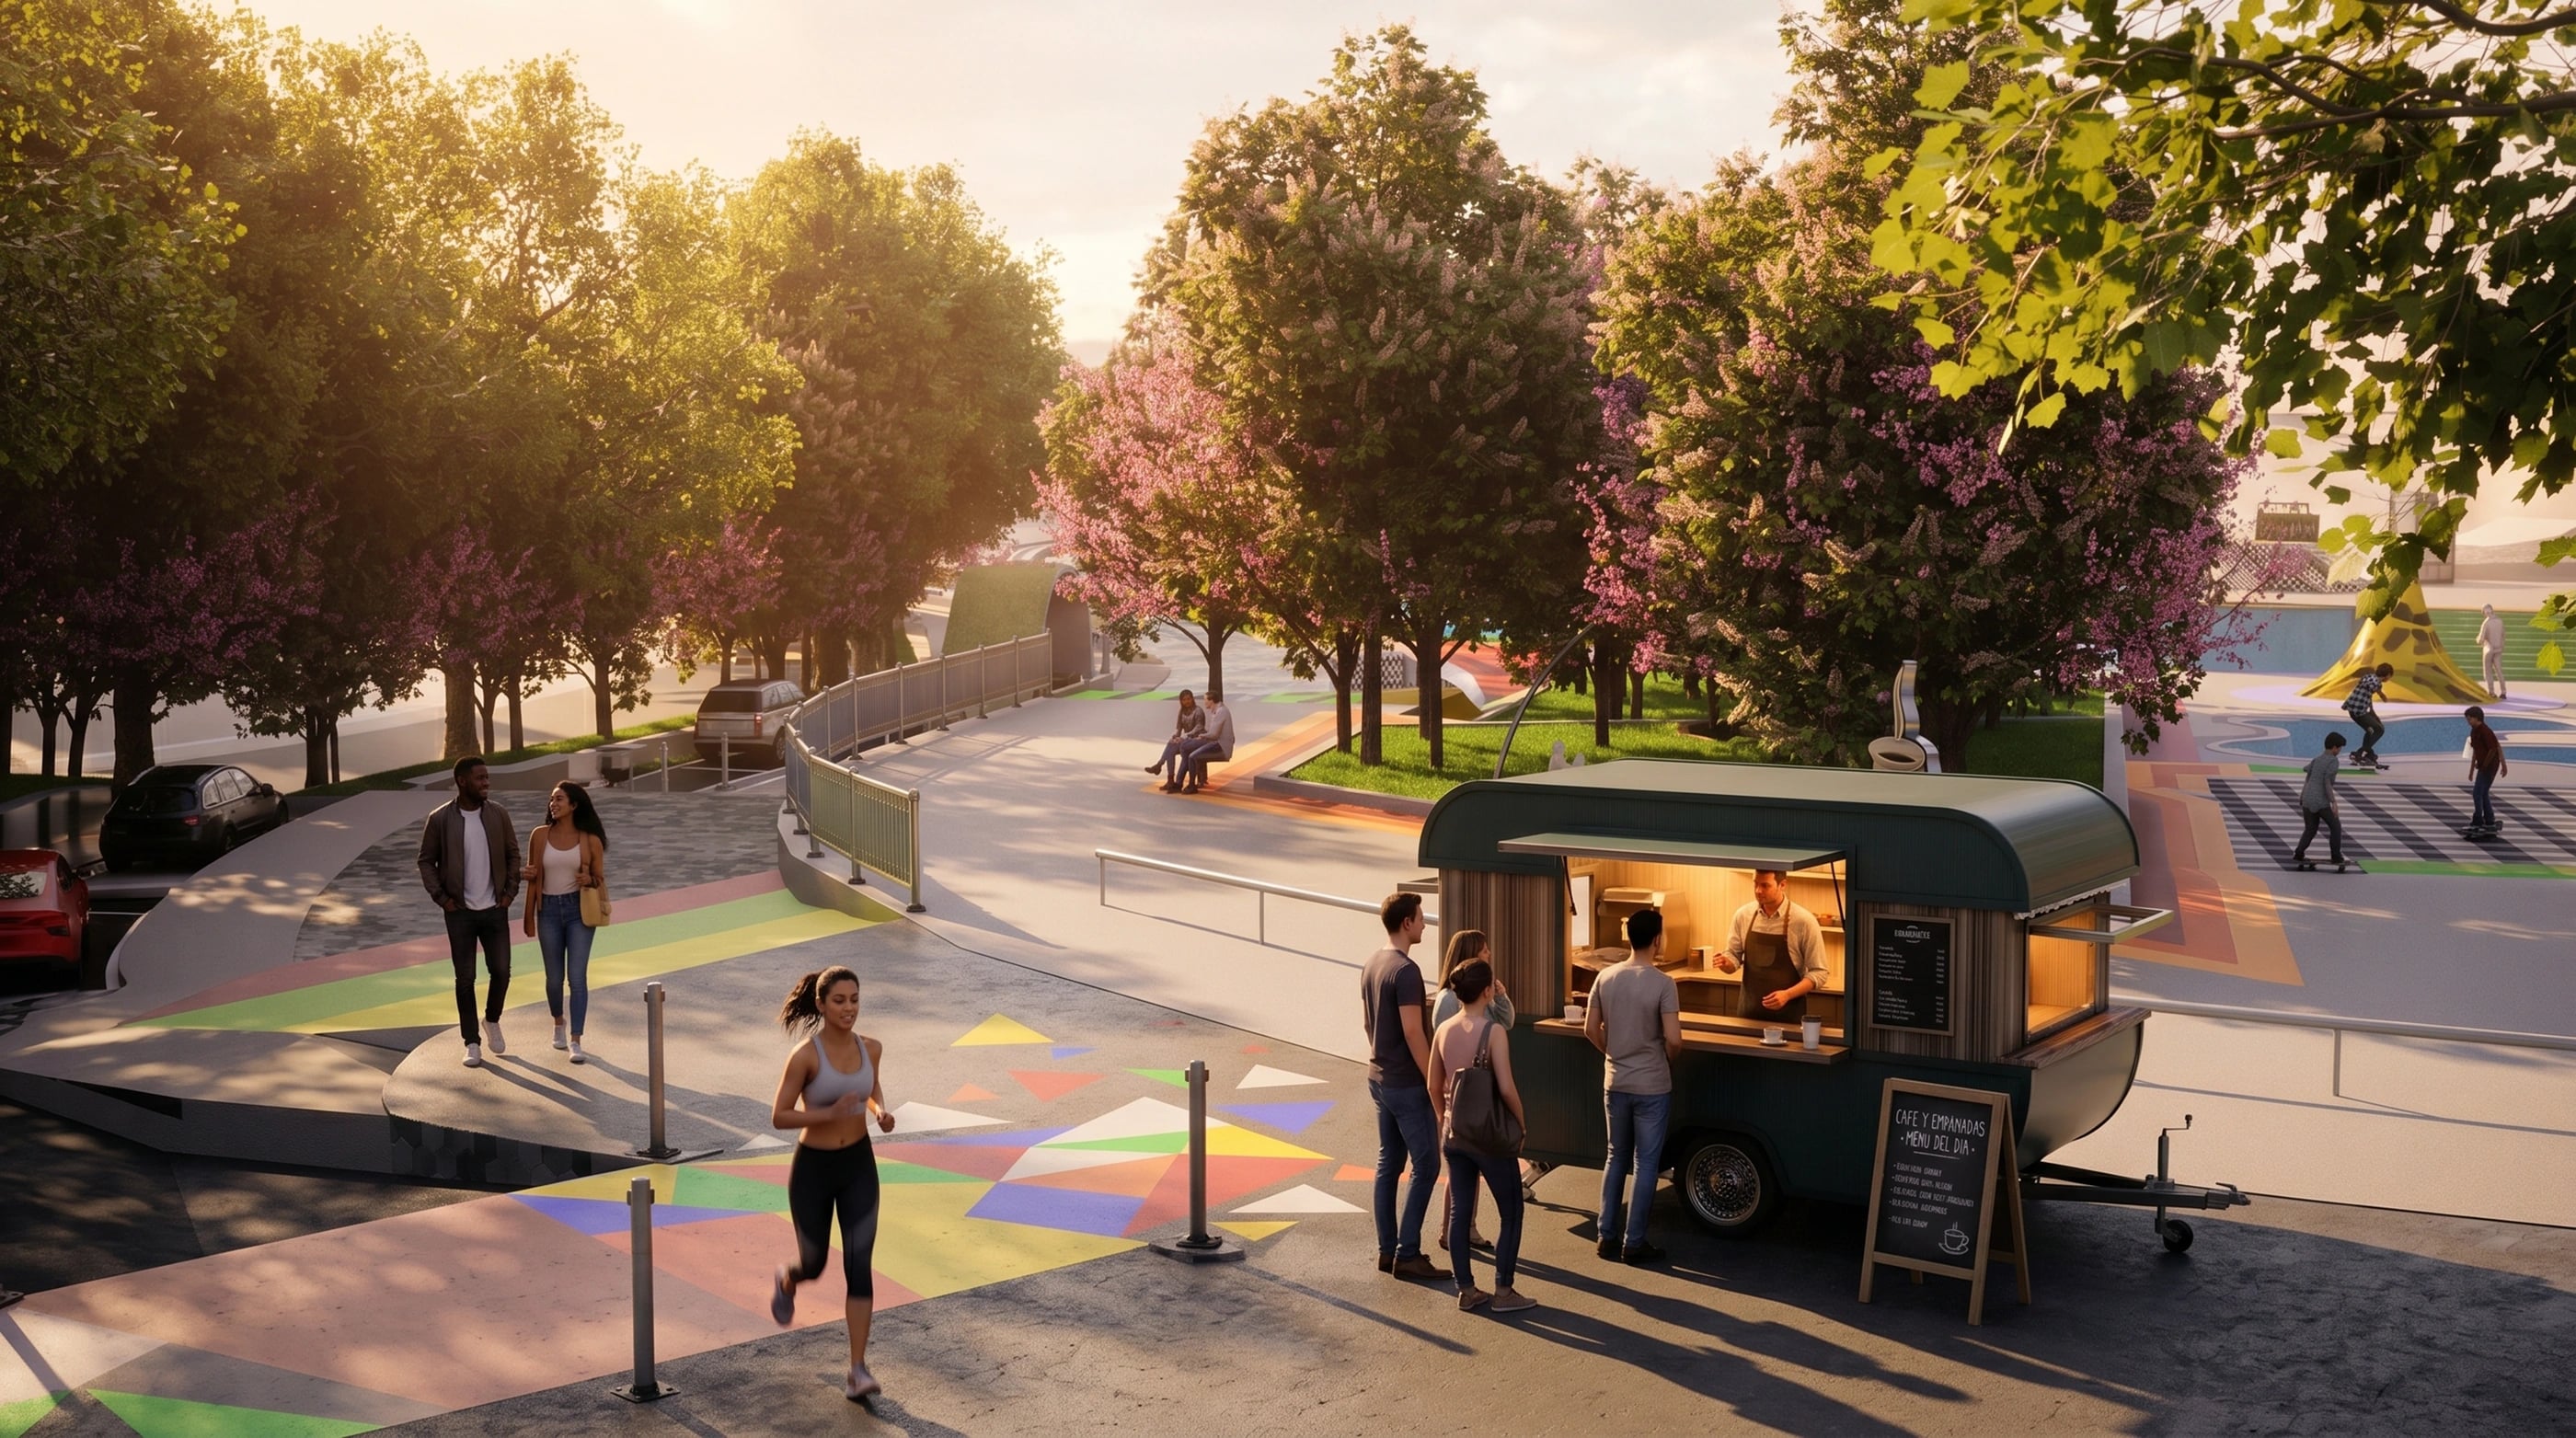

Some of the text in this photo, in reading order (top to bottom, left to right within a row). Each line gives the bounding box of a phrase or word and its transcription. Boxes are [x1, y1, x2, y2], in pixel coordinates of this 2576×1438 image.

[1895, 1109, 1919, 1127] CAFE
[1922, 1111, 1929, 1128] Y
[1905, 1130, 1969, 1156] MENU DEL DIA
